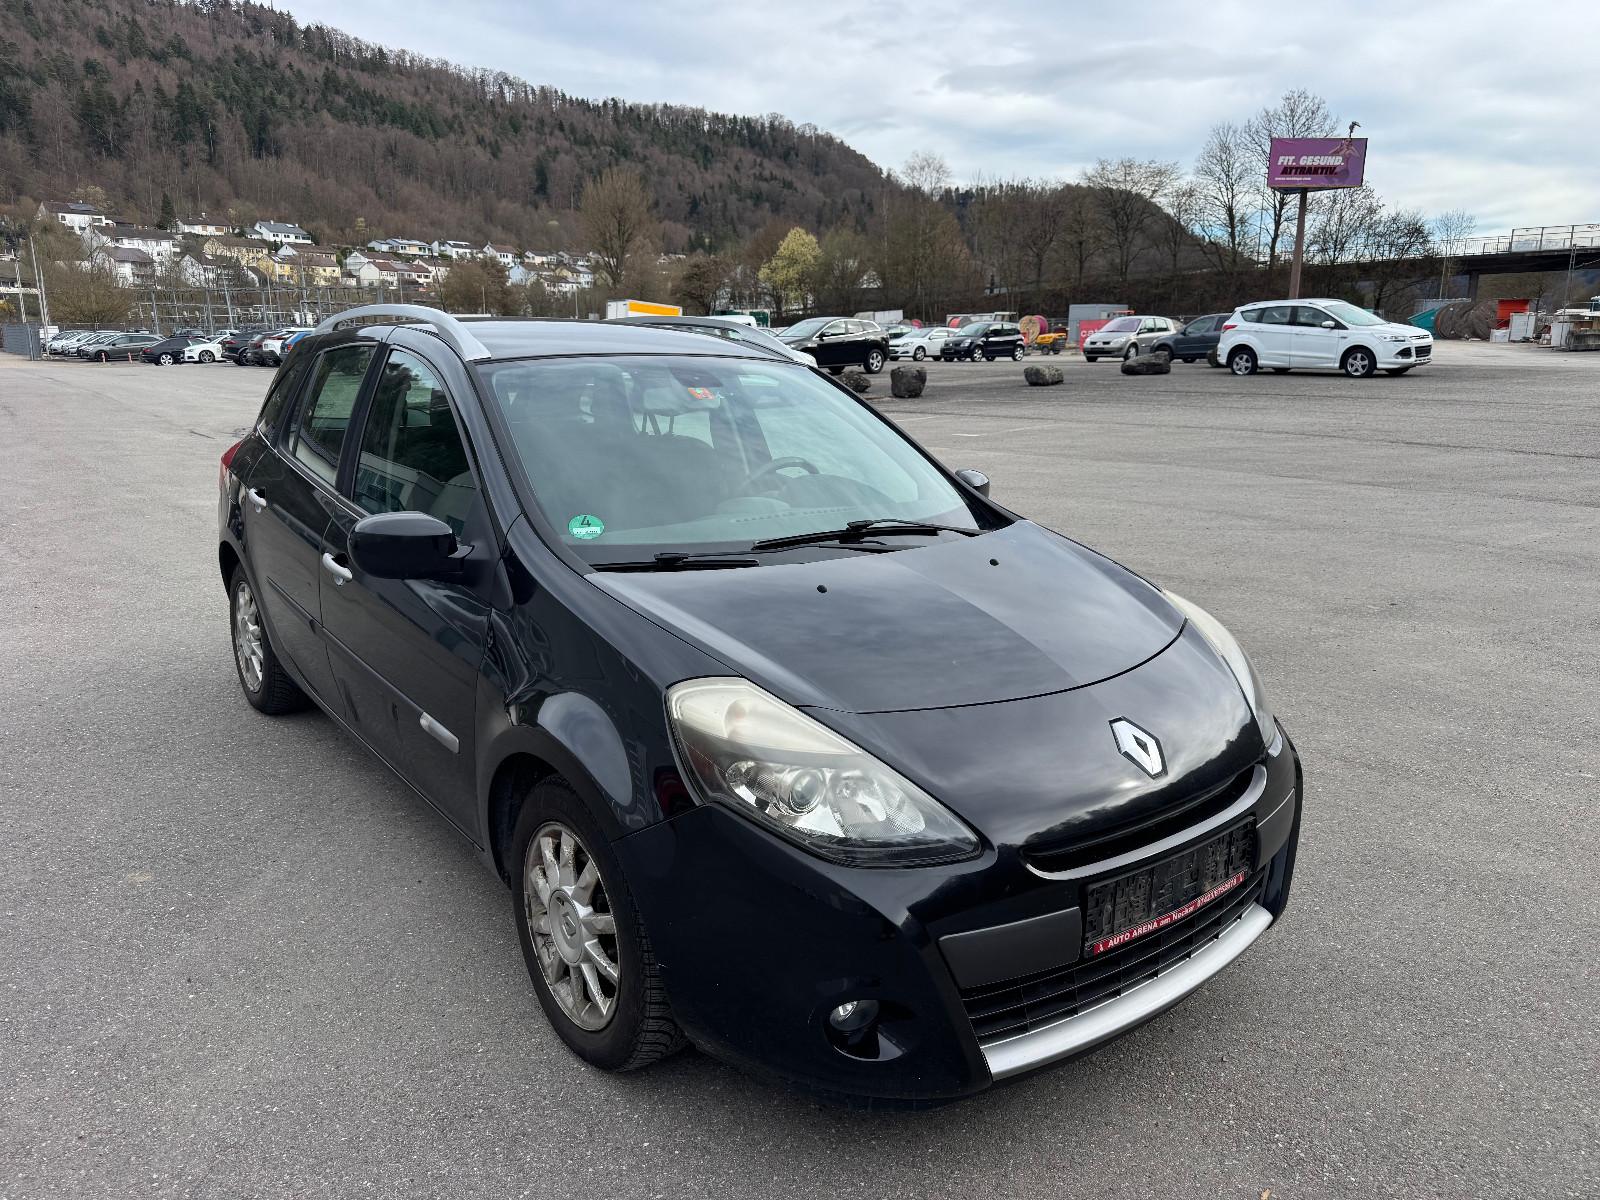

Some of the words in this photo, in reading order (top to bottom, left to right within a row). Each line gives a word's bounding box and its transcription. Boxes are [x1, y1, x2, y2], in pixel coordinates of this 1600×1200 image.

[1277, 155, 1296, 166] FIT.
[1299, 155, 1345, 166] GESUND.
[1280, 166, 1338, 175] ATTRAKTIV.
[581, 515, 591, 527] 4
[1107, 932, 1130, 948] AUTO
[1132, 921, 1158, 937] ARENA
